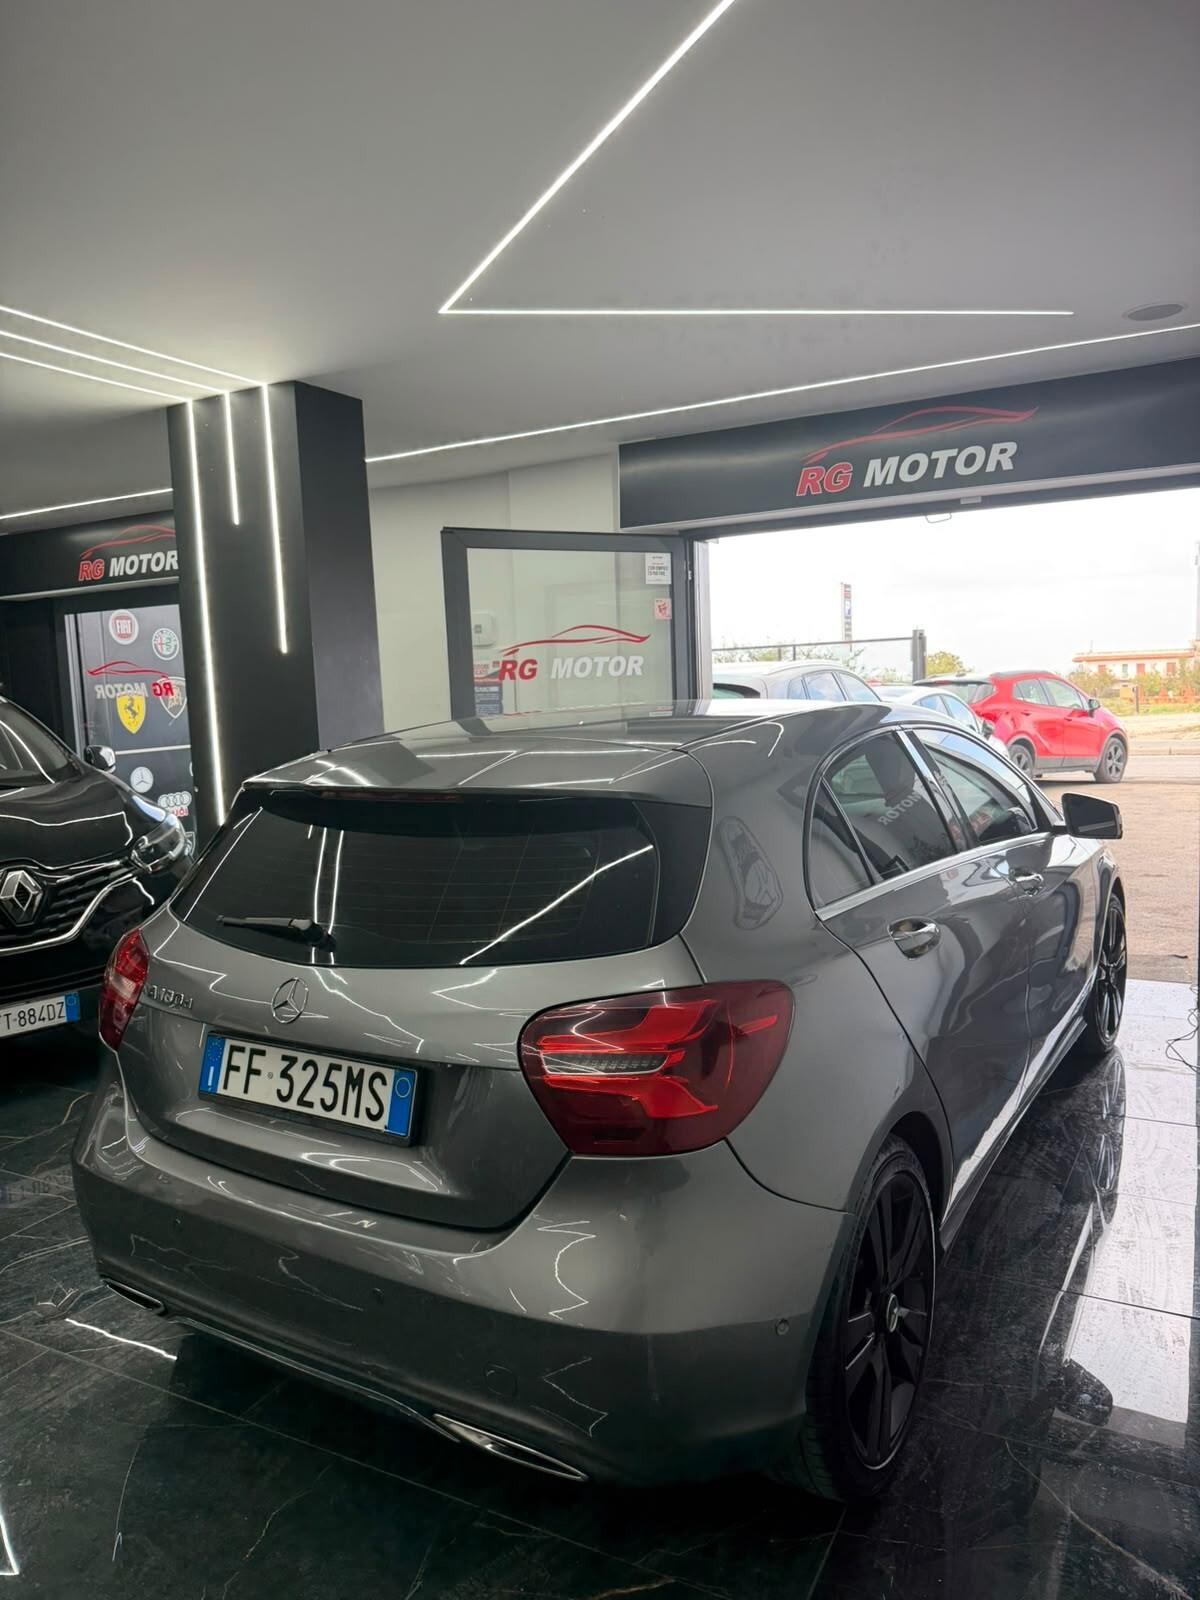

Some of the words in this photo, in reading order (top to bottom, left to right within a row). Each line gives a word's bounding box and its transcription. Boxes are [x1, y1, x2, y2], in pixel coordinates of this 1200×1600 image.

[796, 462, 853, 497] RG
[863, 441, 1018, 488] MOTOR
[78, 558, 105, 582] RG
[109, 550, 179, 577] MOTOR
[498, 659, 538, 681] RG
[551, 656, 644, 679] MOTOR
[223, 1045, 266, 1094] FF
[276, 1054, 387, 1122] 325MS
